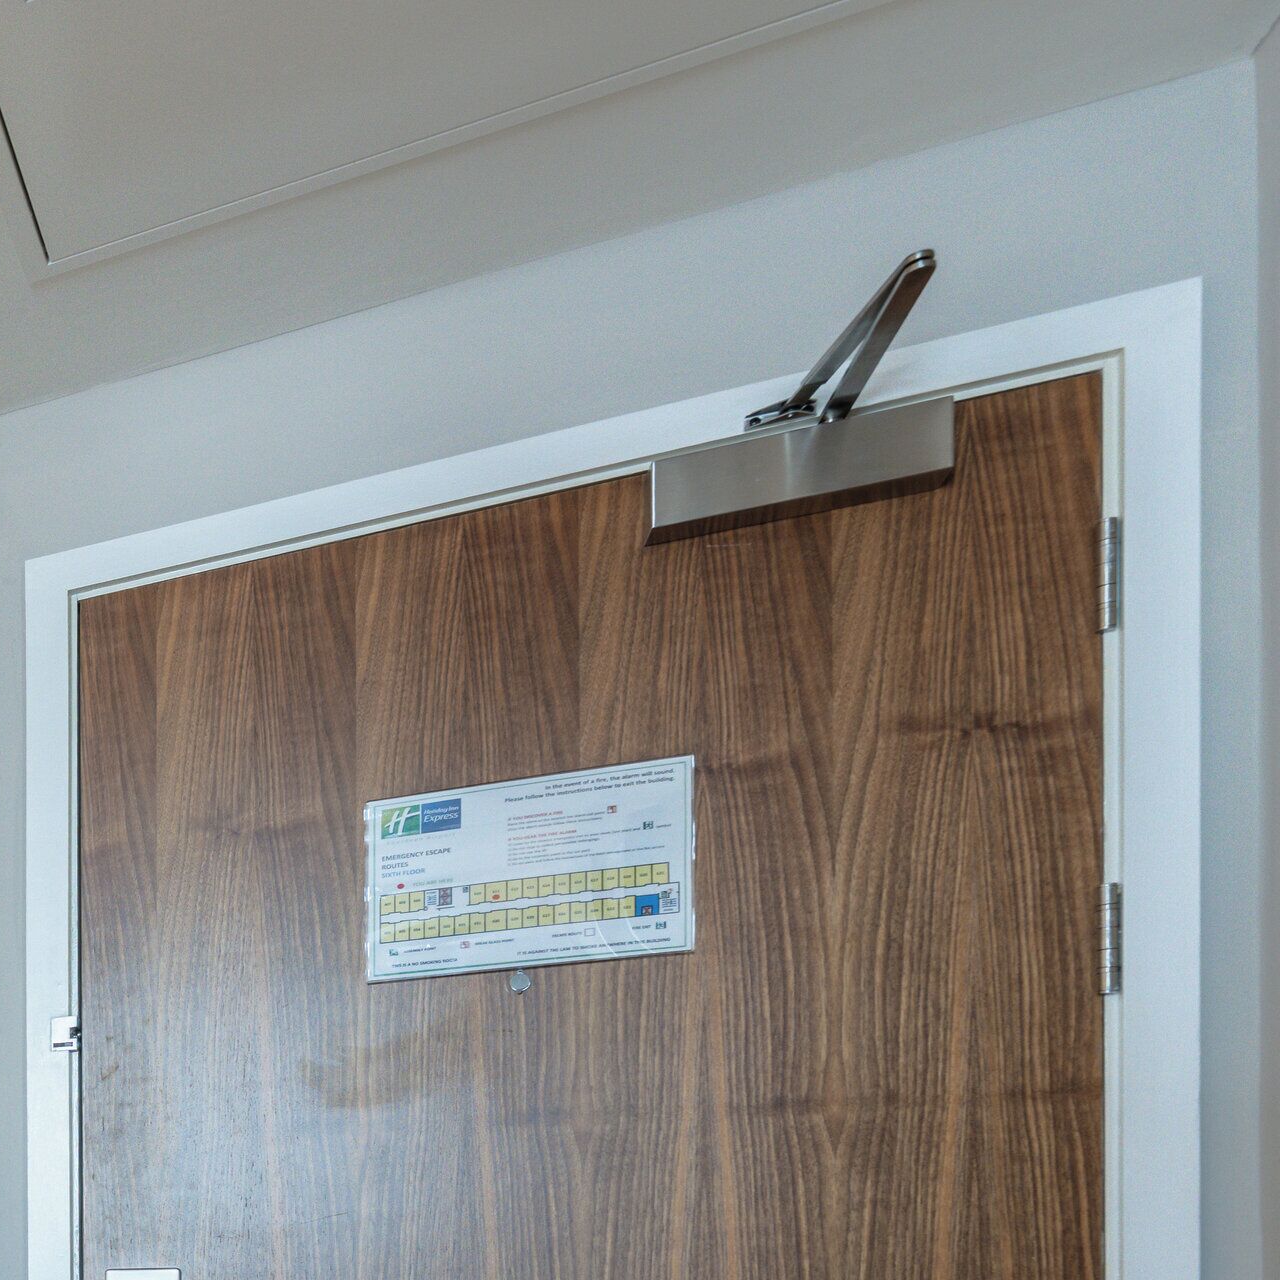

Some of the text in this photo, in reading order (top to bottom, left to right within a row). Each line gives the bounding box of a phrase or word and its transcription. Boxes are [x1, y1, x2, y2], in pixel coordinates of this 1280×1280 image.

[557, 787, 593, 796] instructions
[424, 807, 448, 815] Holiday
[424, 812, 459, 823] Express
[382, 847, 451, 862] EMERGENCY ESCAPE
[381, 861, 409, 870] ROUTES
[381, 868, 425, 879] SIXTH FLOOR
